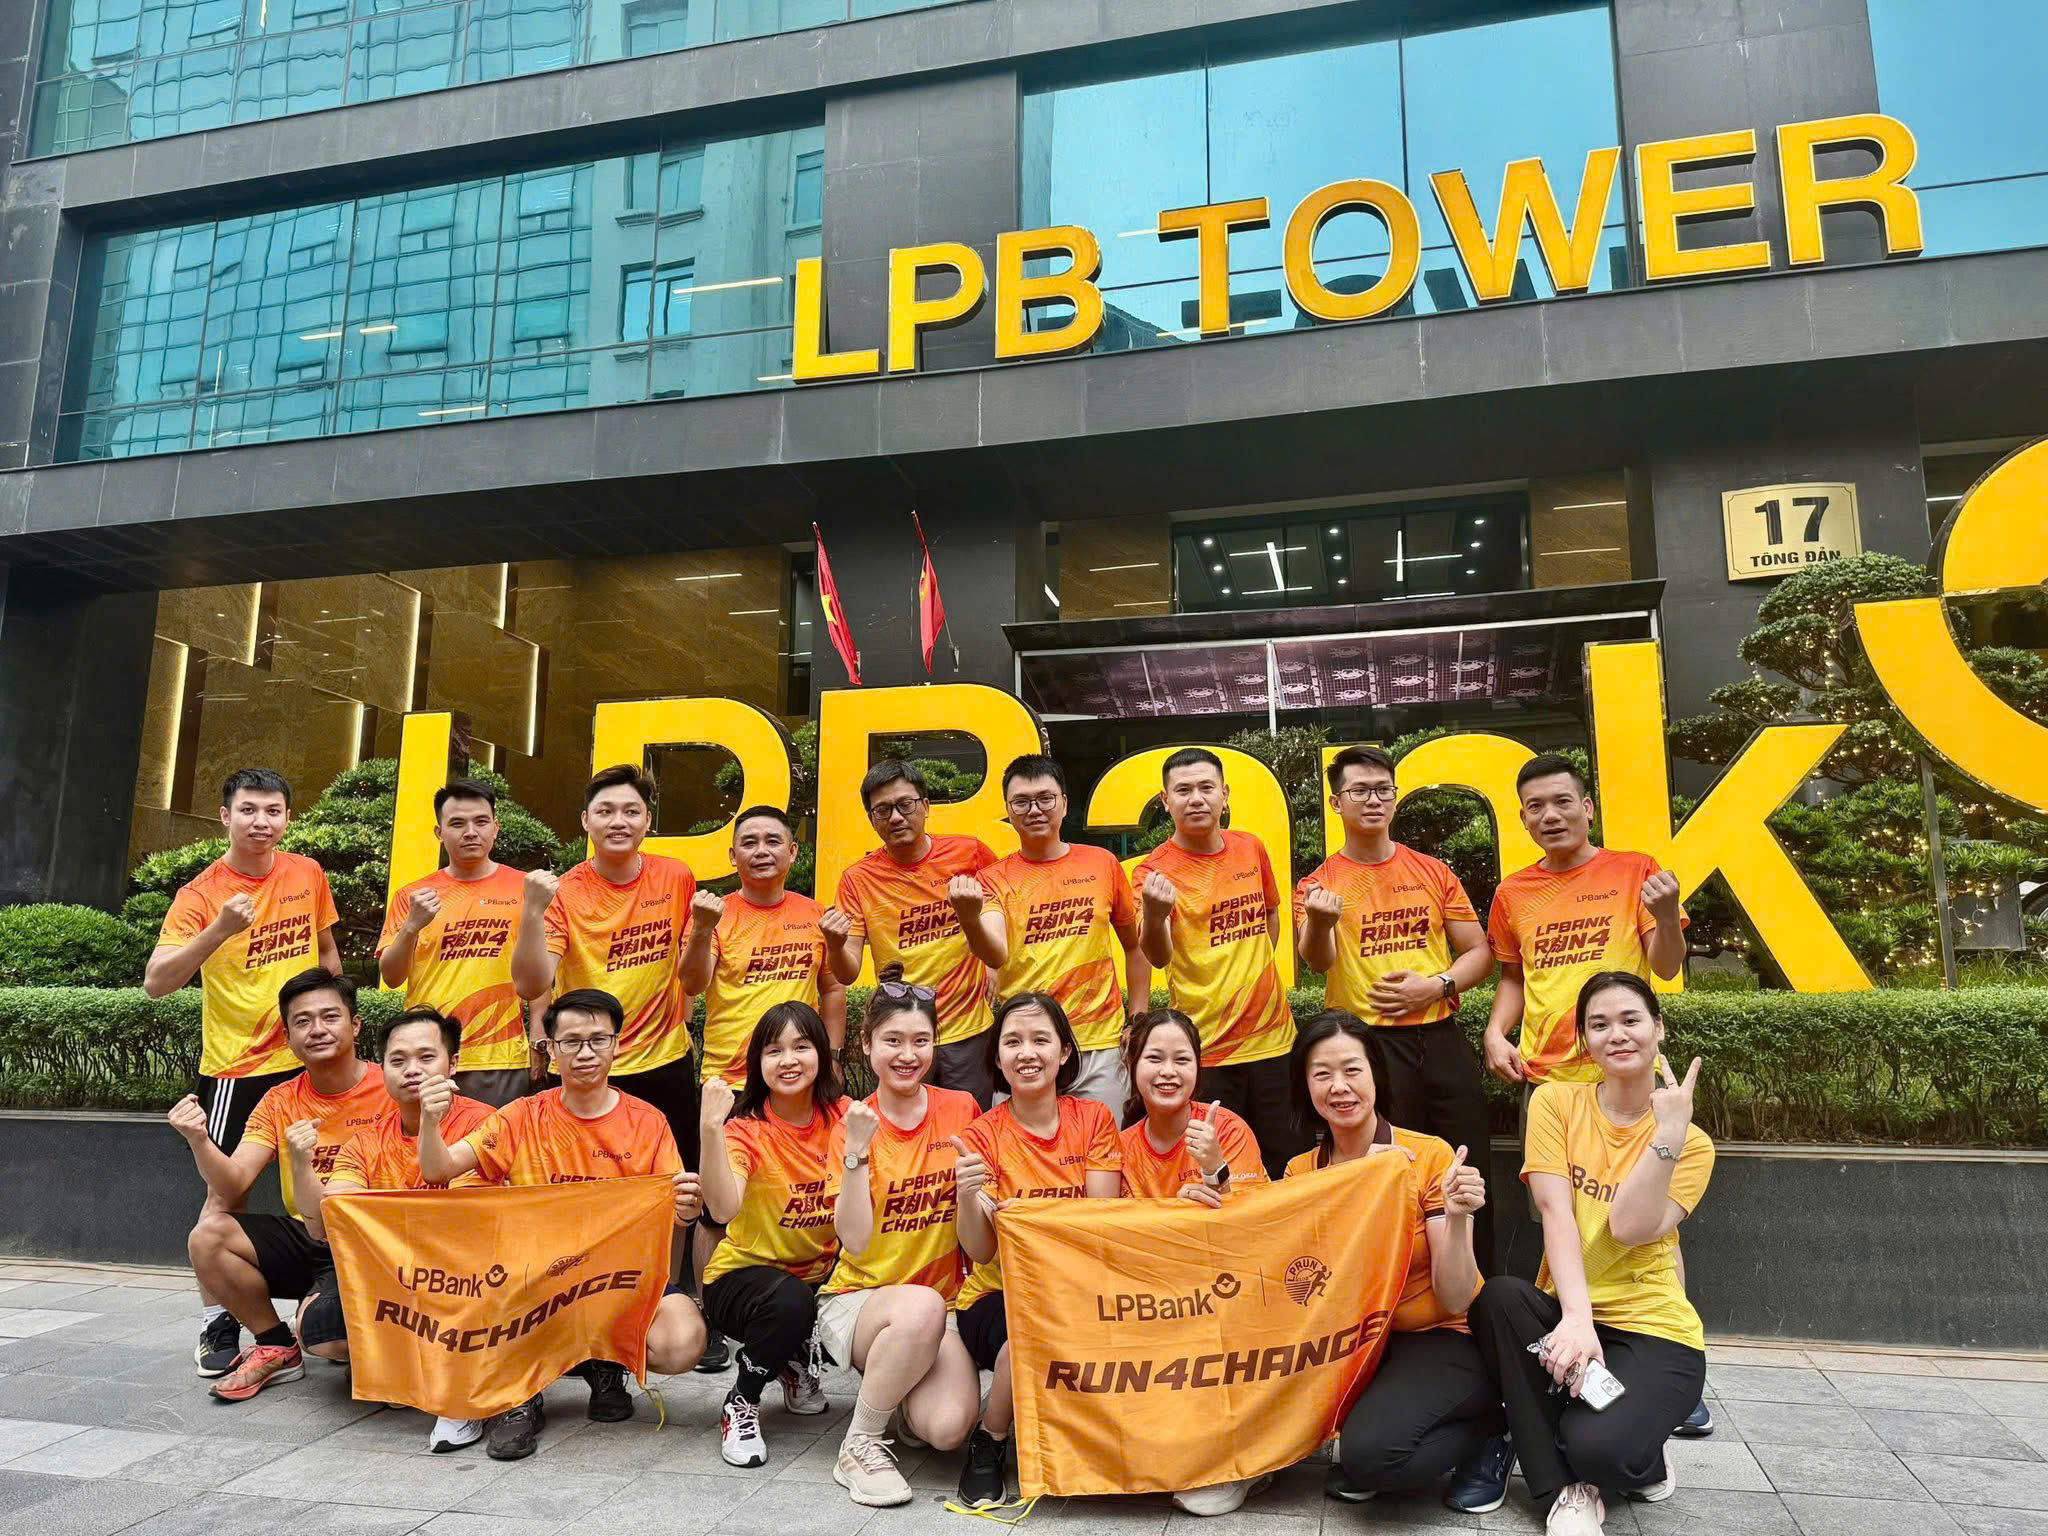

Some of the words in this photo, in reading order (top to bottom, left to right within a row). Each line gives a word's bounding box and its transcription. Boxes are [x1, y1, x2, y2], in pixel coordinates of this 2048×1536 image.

[793, 223, 1104, 382] LPB
[1157, 113, 1925, 338] TOWER
[1755, 496, 1829, 545] 17
[1063, 877, 1090, 886] LPBank
[1233, 870, 1256, 881] LPBank
[279, 893, 305, 905] LPBank
[641, 896, 666, 908] LPBank
[1029, 897, 1094, 914] LPBANK
[1211, 892, 1263, 914] LPBANK
[1576, 892, 1609, 903] LPBank
[900, 899, 952, 920] LPBAN
[1026, 908, 1094, 931] RUN4
[1210, 904, 1265, 933] RUN4
[1362, 906, 1430, 925] LPBANK
[250, 913, 310, 939] LPBANK
[444, 918, 511, 933] LPBANK
[611, 918, 672, 942] LPBANK
[898, 925, 960, 949] CHANGE
[1024, 925, 1089, 944] CHANGE
[1211, 923, 1266, 947] CHANGE
[1360, 918, 1429, 944] RUN4
[1535, 915, 1614, 938] LPBANK
[247, 925, 311, 956] RUN4
[440, 930, 509, 950] RUN4
[608, 930, 672, 960] RUN4
[751, 943, 813, 956] LPBANK
[1360, 938, 1427, 958] CHANGE
[1534, 928, 1610, 956] RUN4
[245, 944, 310, 969] CHANGE
[607, 948, 669, 972] CHANGE
[746, 953, 813, 973] RUN4
[744, 970, 809, 984] CHANGE
[346, 1116, 374, 1127] LPBank
[881, 1209, 955, 1234] CHANGE
[398, 1265, 483, 1298] LPBank
[374, 1270, 642, 1353] RUN4CHANGE
[1097, 1288, 1214, 1321] LPBank
[1046, 1310, 1389, 1394] RUN4CHANGE
